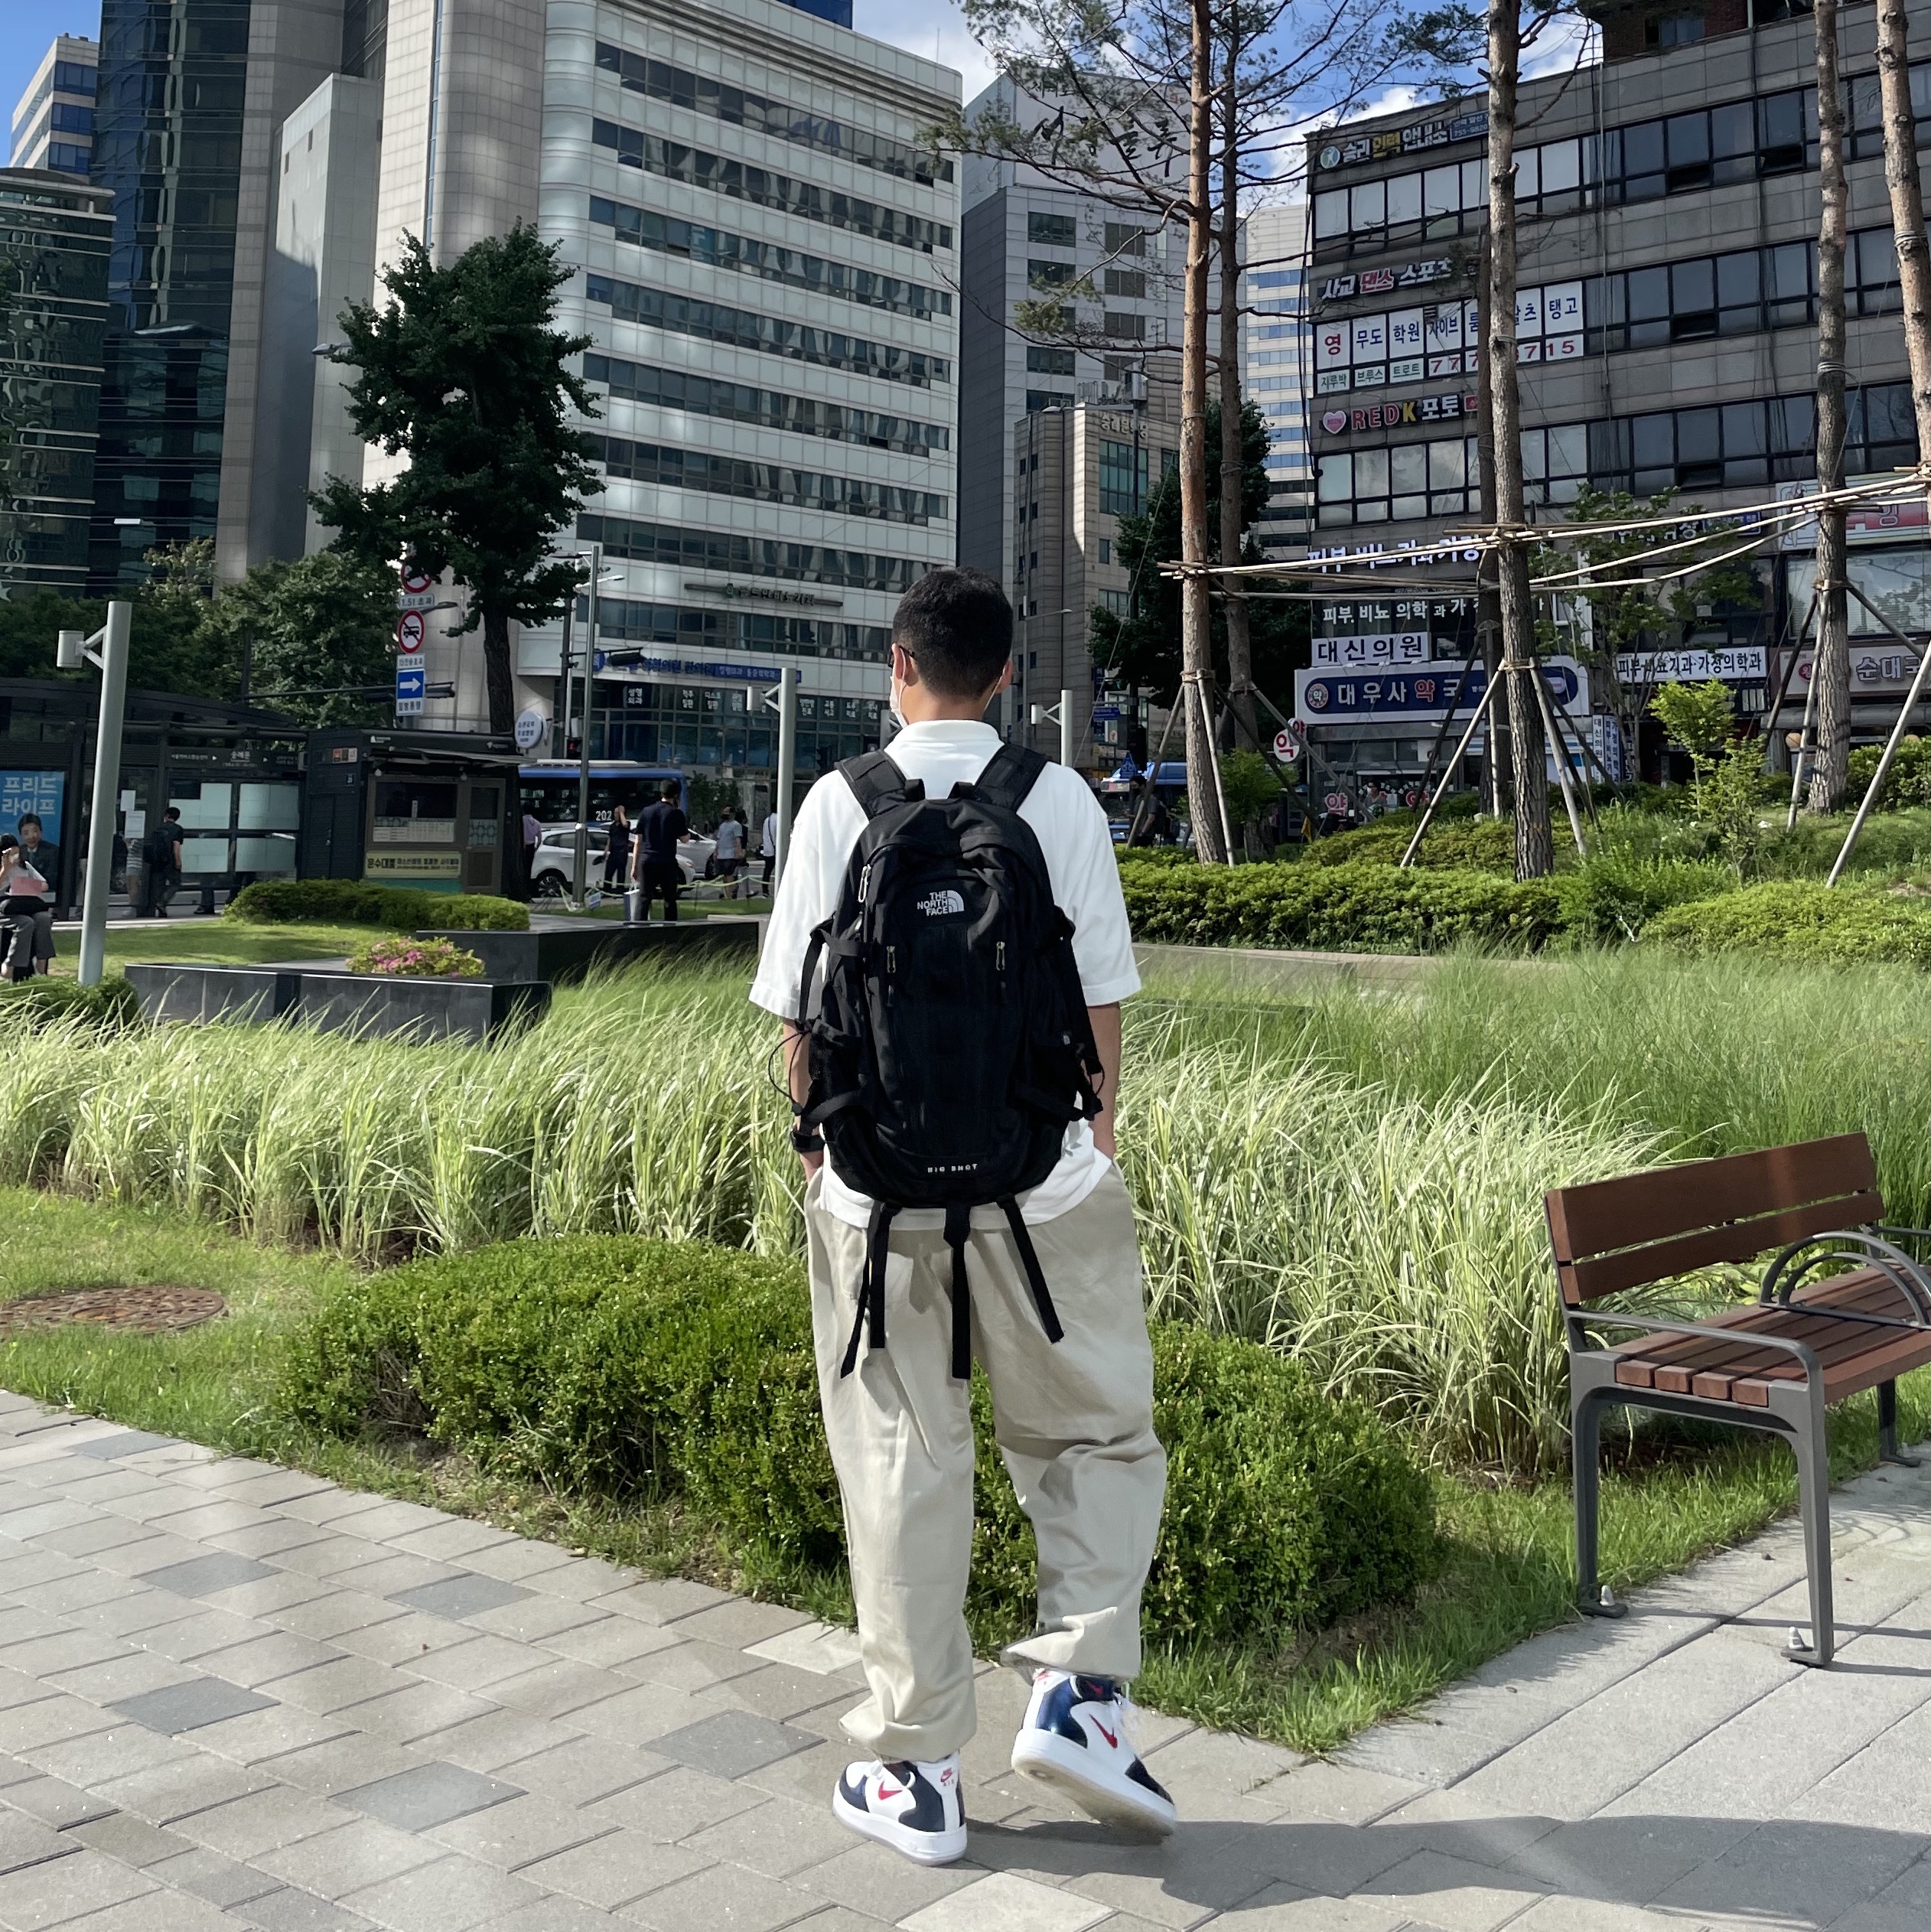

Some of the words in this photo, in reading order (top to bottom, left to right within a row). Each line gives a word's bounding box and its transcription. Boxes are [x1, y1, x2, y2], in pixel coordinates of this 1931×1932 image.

[1360, 268, 1394, 294] 댄스
[1356, 327, 1382, 350] 무도
[1392, 321, 1420, 344] 학원
[1428, 316, 1459, 338] 자이브
[1549, 298, 1578, 321] 탱고
[1356, 369, 1384, 383] 브루스
[1317, 636, 1422, 663] 대신의원
[2, 776, 58, 796] 프리드
[1, 797, 57, 816] 라이프
[917, 898, 949, 911] NORTH
[930, 891, 948, 901] THE
[926, 906, 949, 917] FACE
